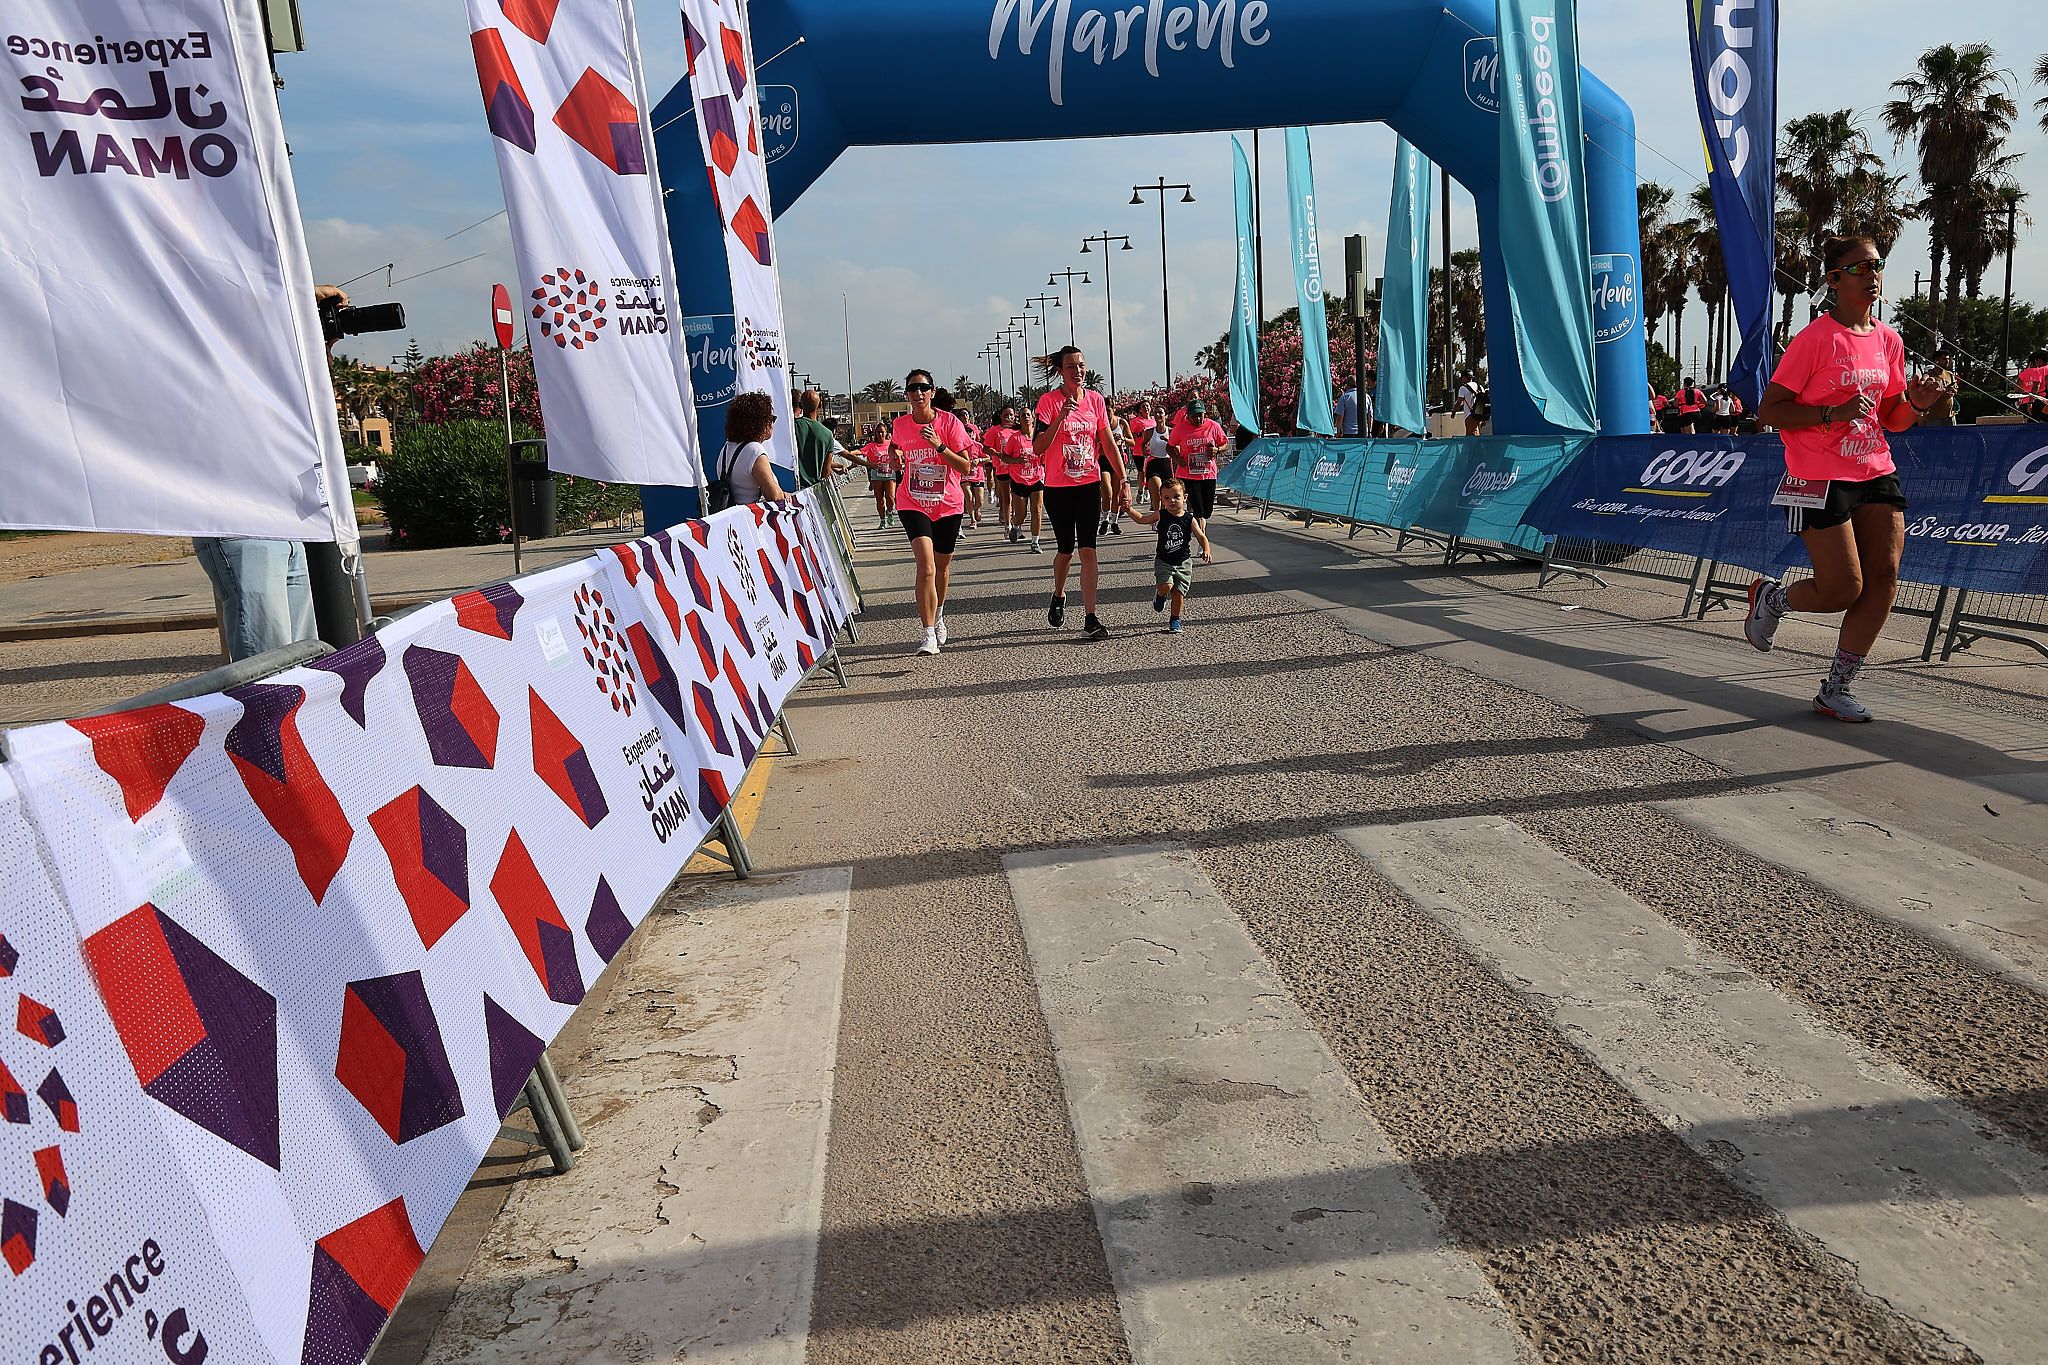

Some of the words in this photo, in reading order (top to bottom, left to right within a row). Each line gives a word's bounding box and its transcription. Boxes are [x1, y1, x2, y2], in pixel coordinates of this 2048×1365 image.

[988, 0, 1271, 105] Marlene
[1477, 93, 1494, 106] HIJA
[1610, 317, 1630, 336] ALPES
[696, 393, 714, 403] LOS
[919, 480, 934, 488] 016
[1461, 462, 1520, 497] Compeed
[1639, 449, 1747, 487] GOYA
[622, 726, 662, 766] Experience
[651, 786, 691, 844] OMAN
